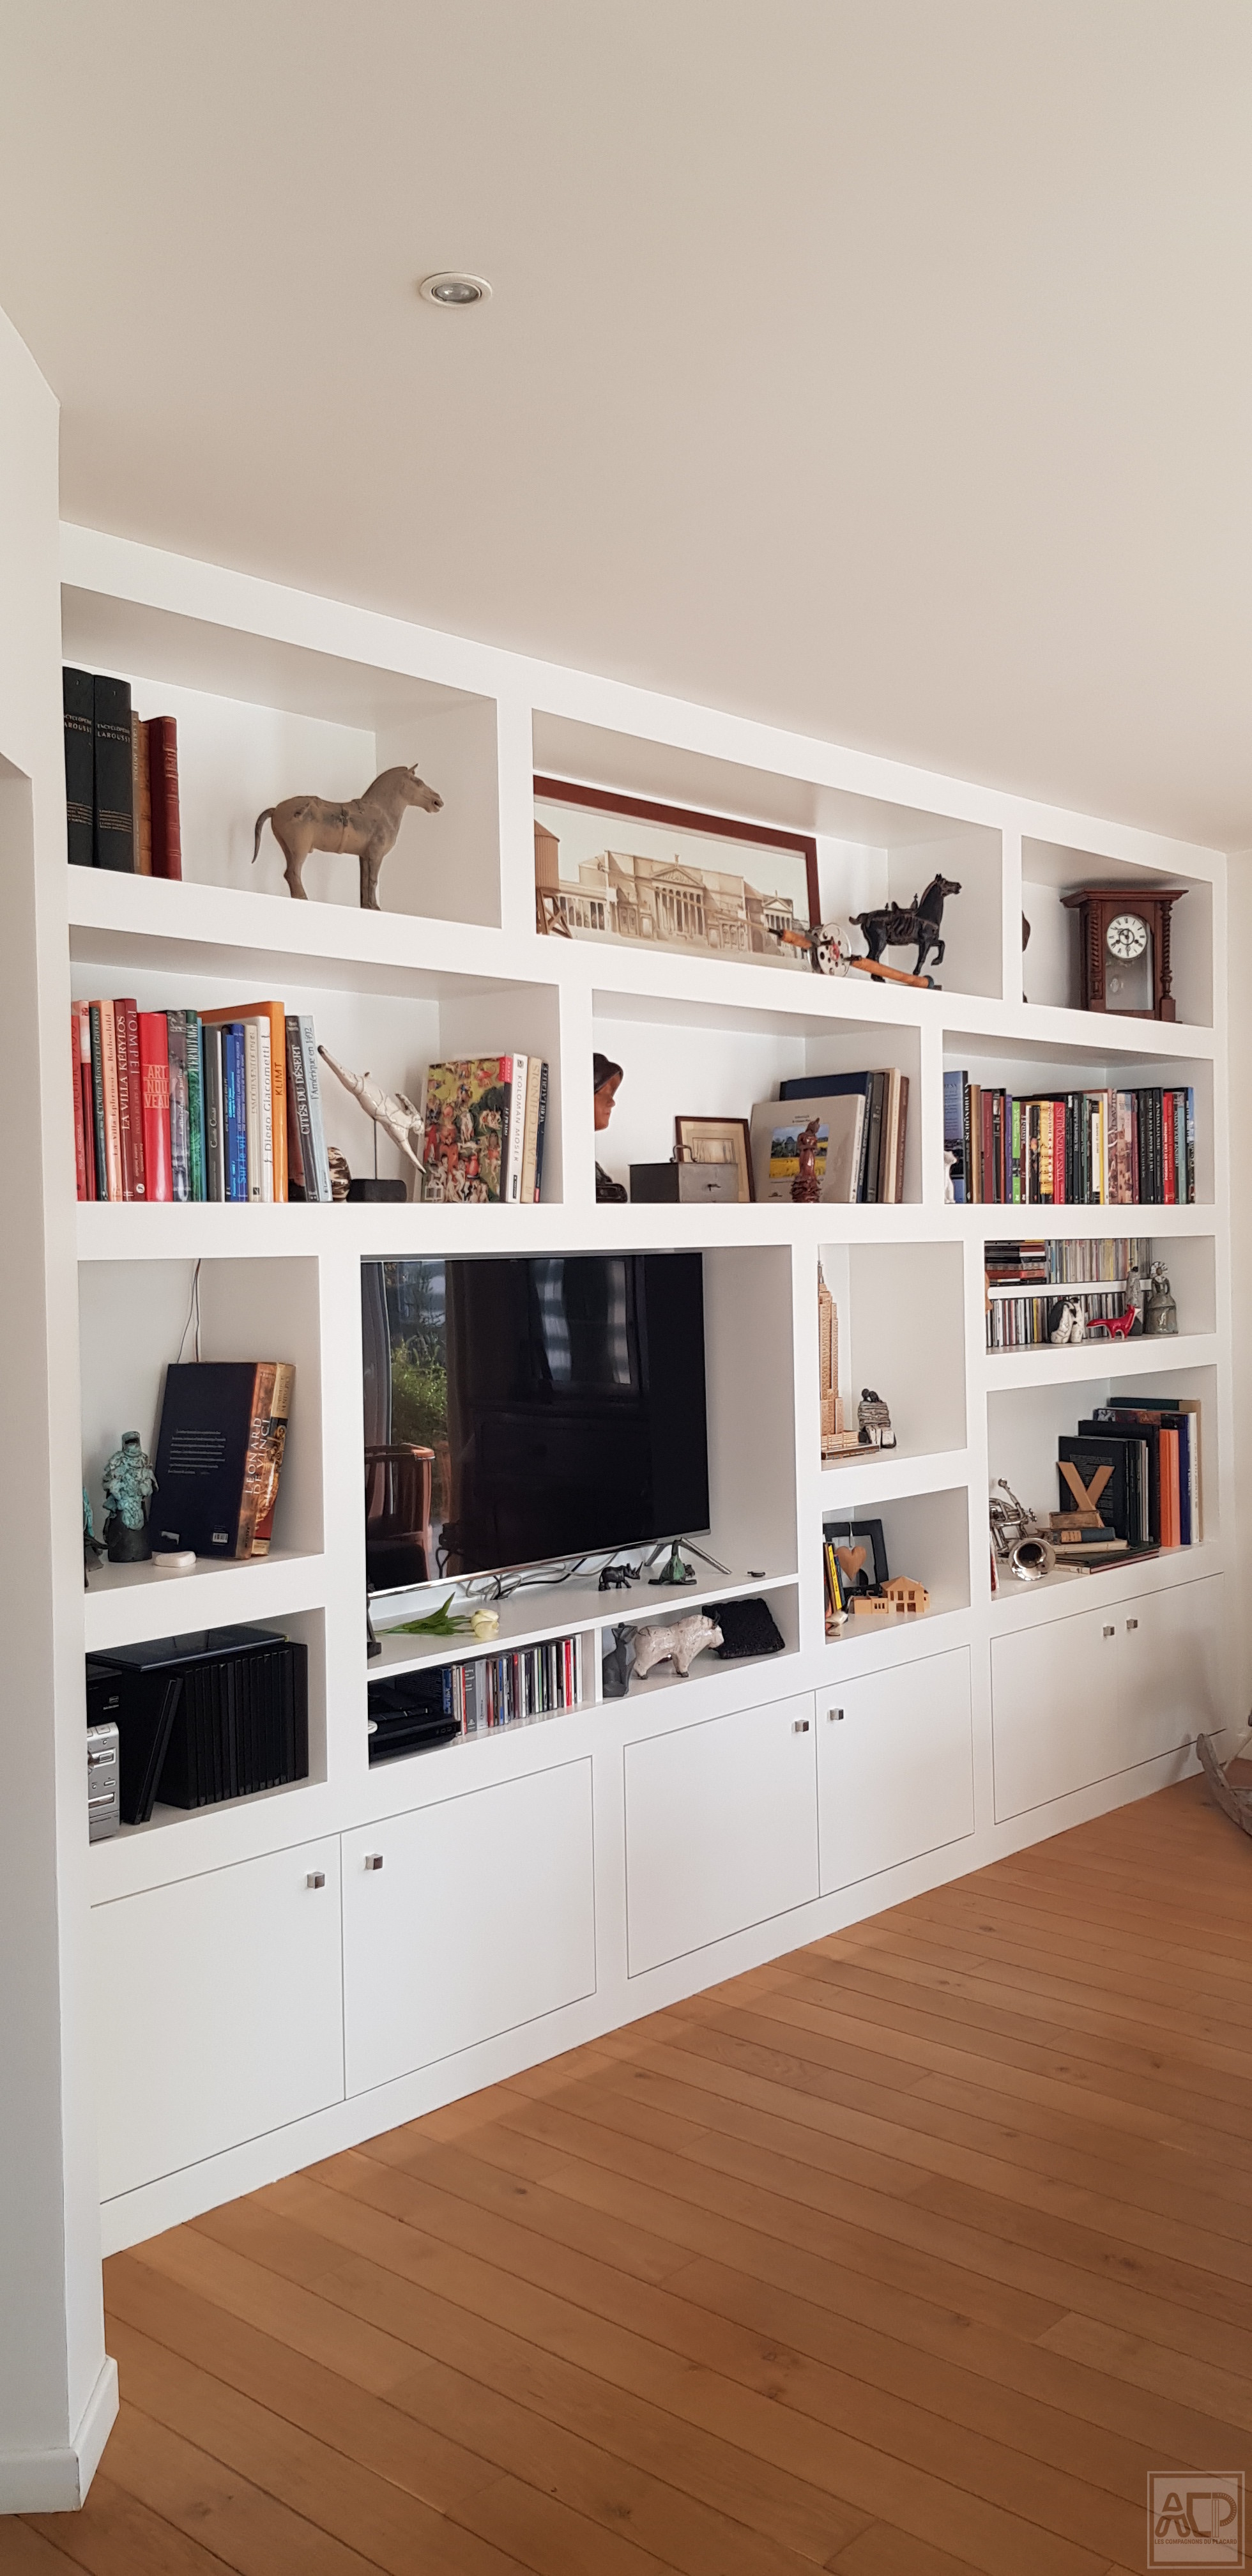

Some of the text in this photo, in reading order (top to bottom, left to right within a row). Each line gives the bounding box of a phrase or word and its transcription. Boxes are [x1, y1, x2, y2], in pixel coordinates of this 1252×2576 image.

[105, 1013, 114, 1062] Rothschild
[128, 1010, 140, 1075] POMPEI
[146, 1080, 167, 1093] NOU
[147, 1066, 167, 1078] ART
[275, 1062, 283, 1096] KLIMT
[303, 1027, 319, 1100] l'Amérique en 1492
[119, 1076, 129, 1111] VILLA
[144, 1094, 169, 1108] VEAU
[261, 1045, 273, 1152] Diego Giacometti
[291, 1045, 311, 1135] CITÉS DU DÉSERT
[515, 1075, 523, 1124] KOLOMAN
[121, 1115, 130, 1130] LA
[236, 1136, 247, 1184] Sur le vif
[253, 1418, 270, 1494] DE VINCI
